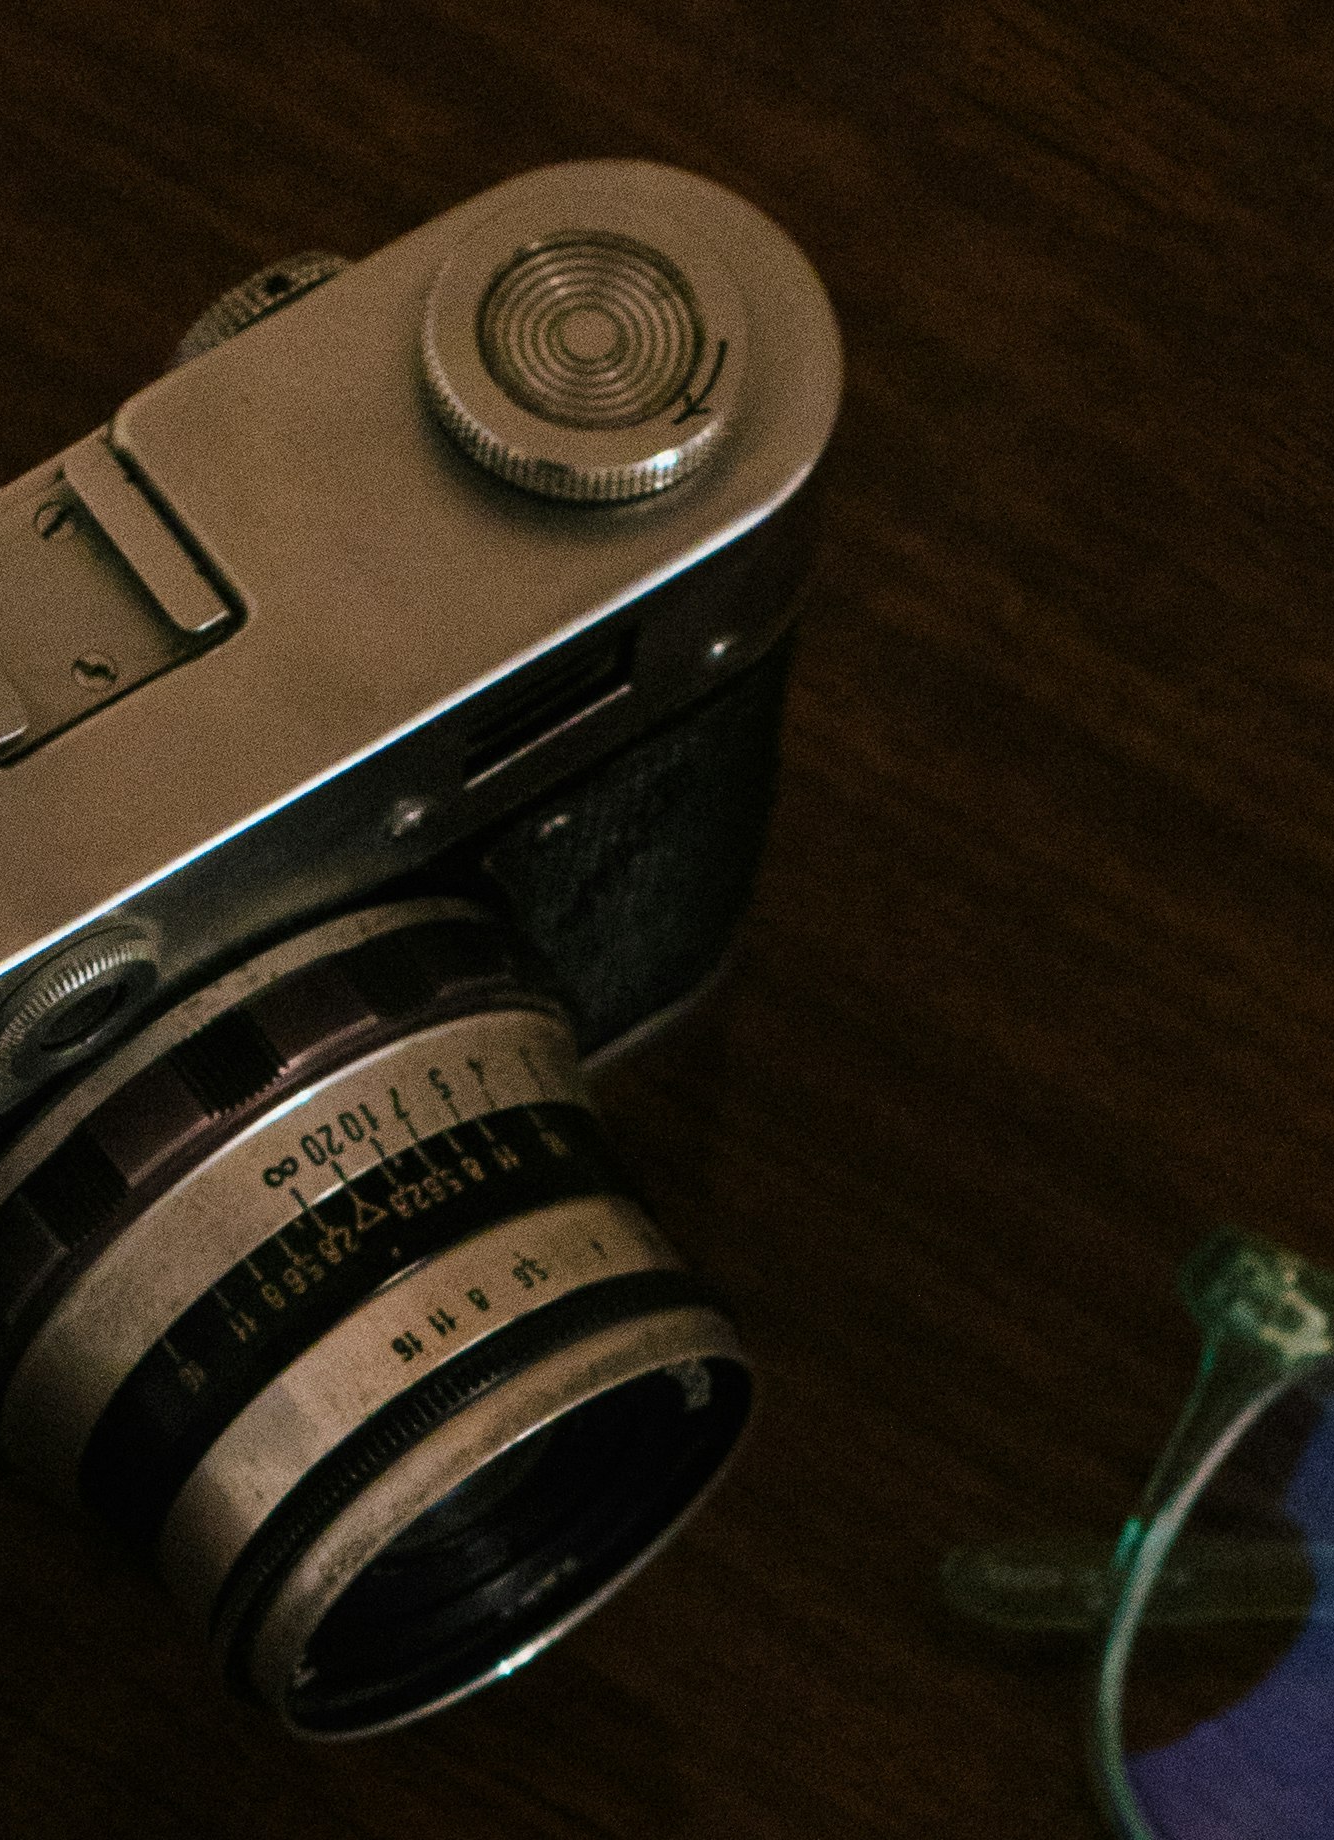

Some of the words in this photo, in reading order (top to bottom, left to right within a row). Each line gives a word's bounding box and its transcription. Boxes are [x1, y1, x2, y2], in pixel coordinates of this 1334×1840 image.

[338, 1103, 379, 1143] 10
[301, 1124, 344, 1167] 20
[426, 1306, 458, 1336] 11
[391, 1330, 424, 1362] 16
